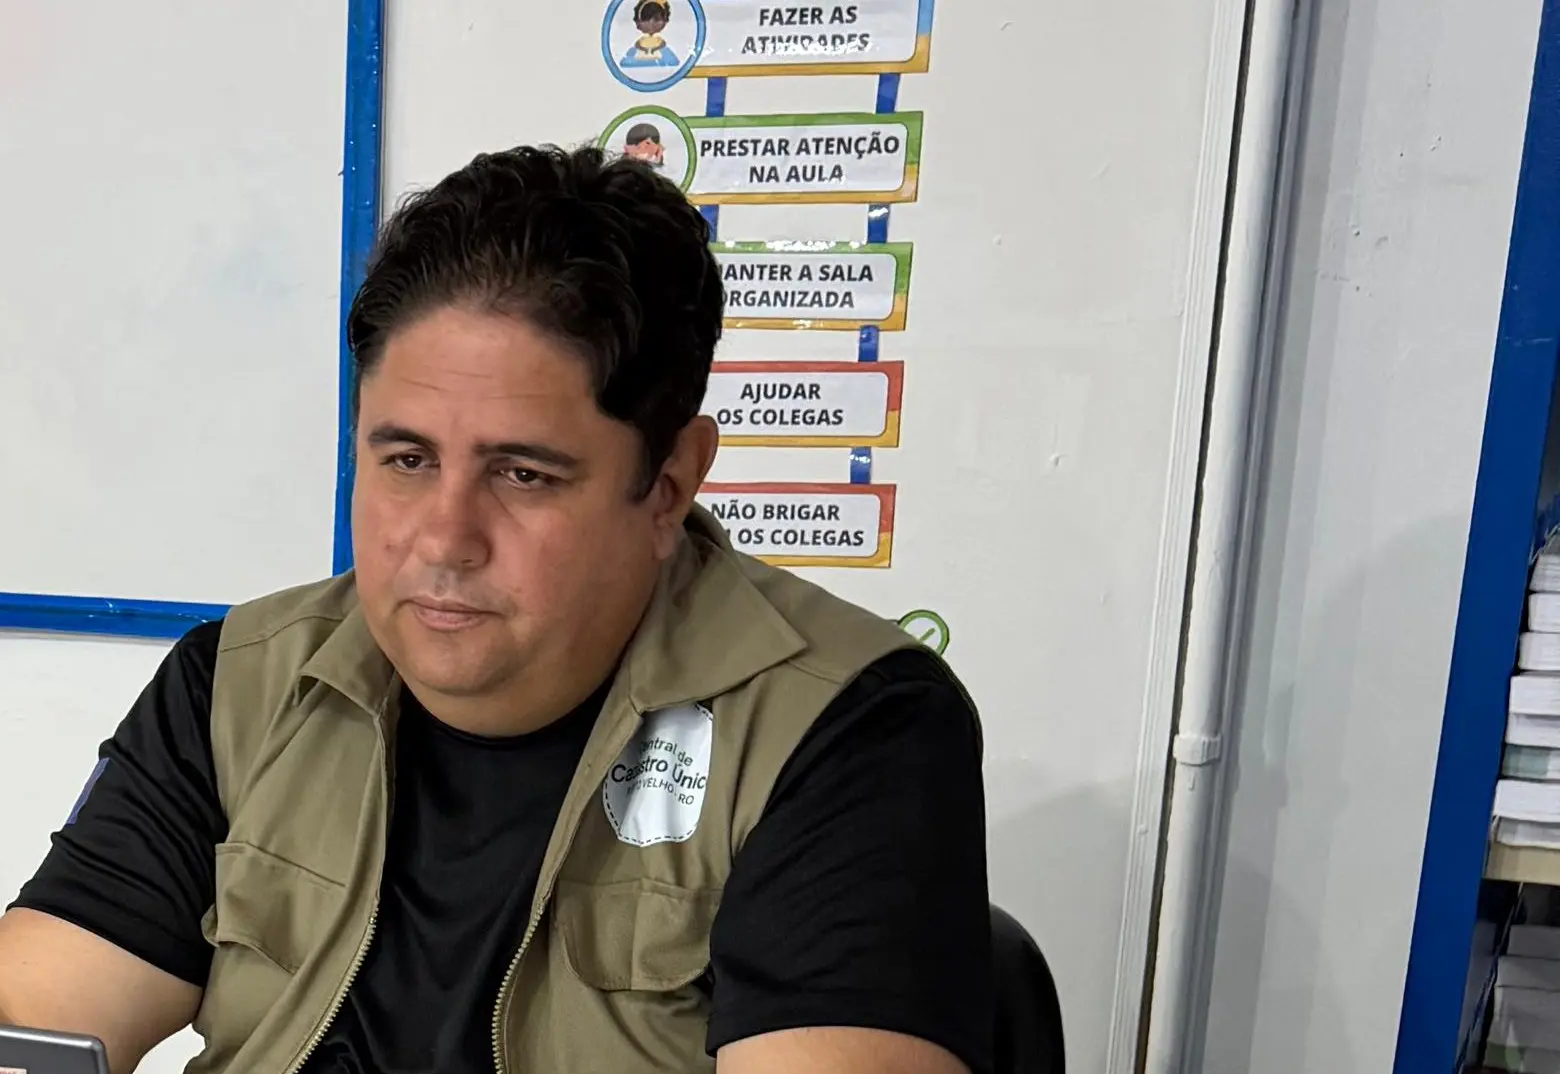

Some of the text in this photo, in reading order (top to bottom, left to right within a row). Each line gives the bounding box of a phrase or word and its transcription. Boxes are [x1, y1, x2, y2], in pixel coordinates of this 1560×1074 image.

[758, 5, 858, 27] FAZER AS
[700, 131, 900, 159] PRESTAR ATENÇÃO
[748, 163, 845, 184] NA AULA
[718, 263, 874, 282] ANTER A SALA
[740, 382, 822, 403] AJUDAR
[749, 408, 844, 426] COLEGAS
[711, 499, 841, 521] NÃO BRIGAR
[737, 528, 765, 545] OS
[770, 529, 865, 547] COLEGAS
[678, 751, 694, 767] de
